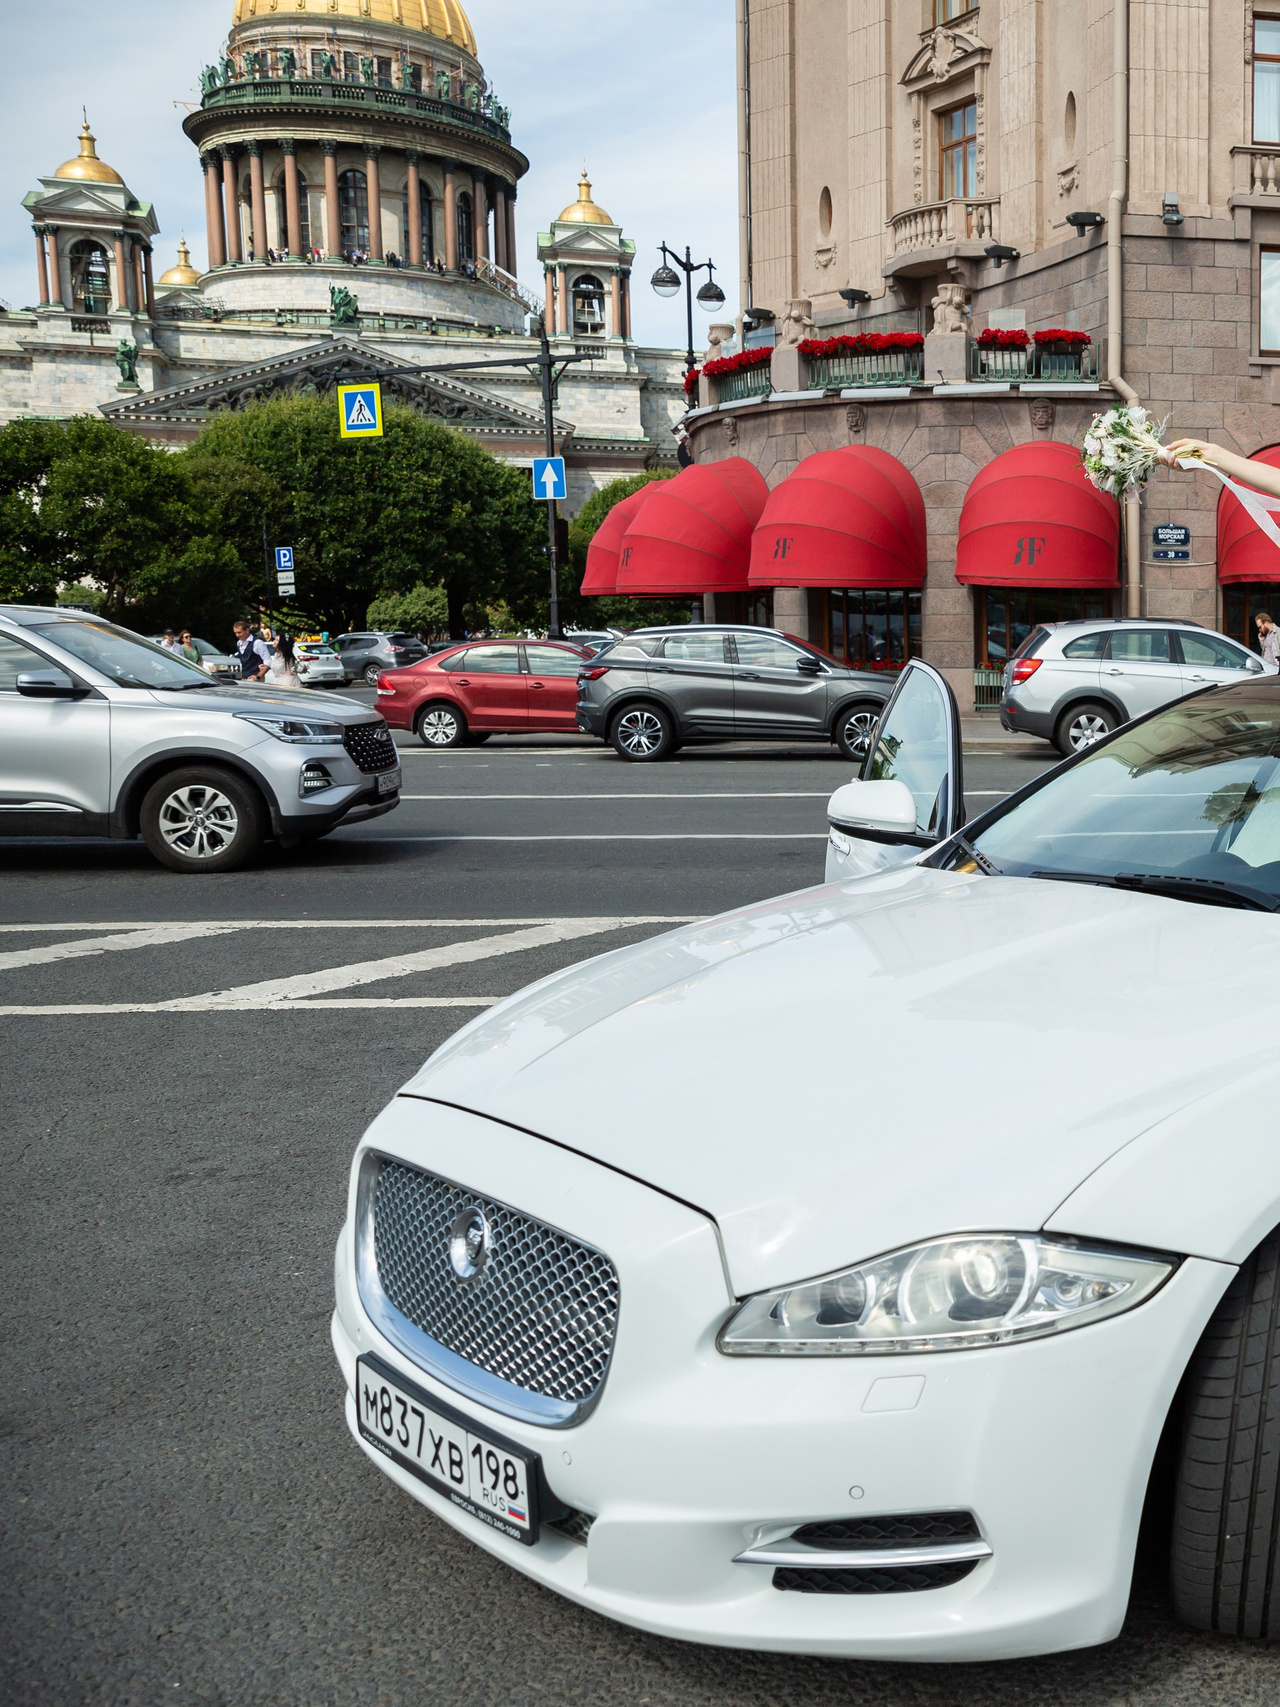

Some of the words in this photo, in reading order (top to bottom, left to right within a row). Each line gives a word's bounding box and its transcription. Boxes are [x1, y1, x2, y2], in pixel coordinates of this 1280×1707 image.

[361, 1431, 392, 1457] JAGUAR
[363, 1383, 464, 1485] М837ХВ
[471, 1443, 519, 1500] 198
[483, 1487, 506, 1511] RUS
